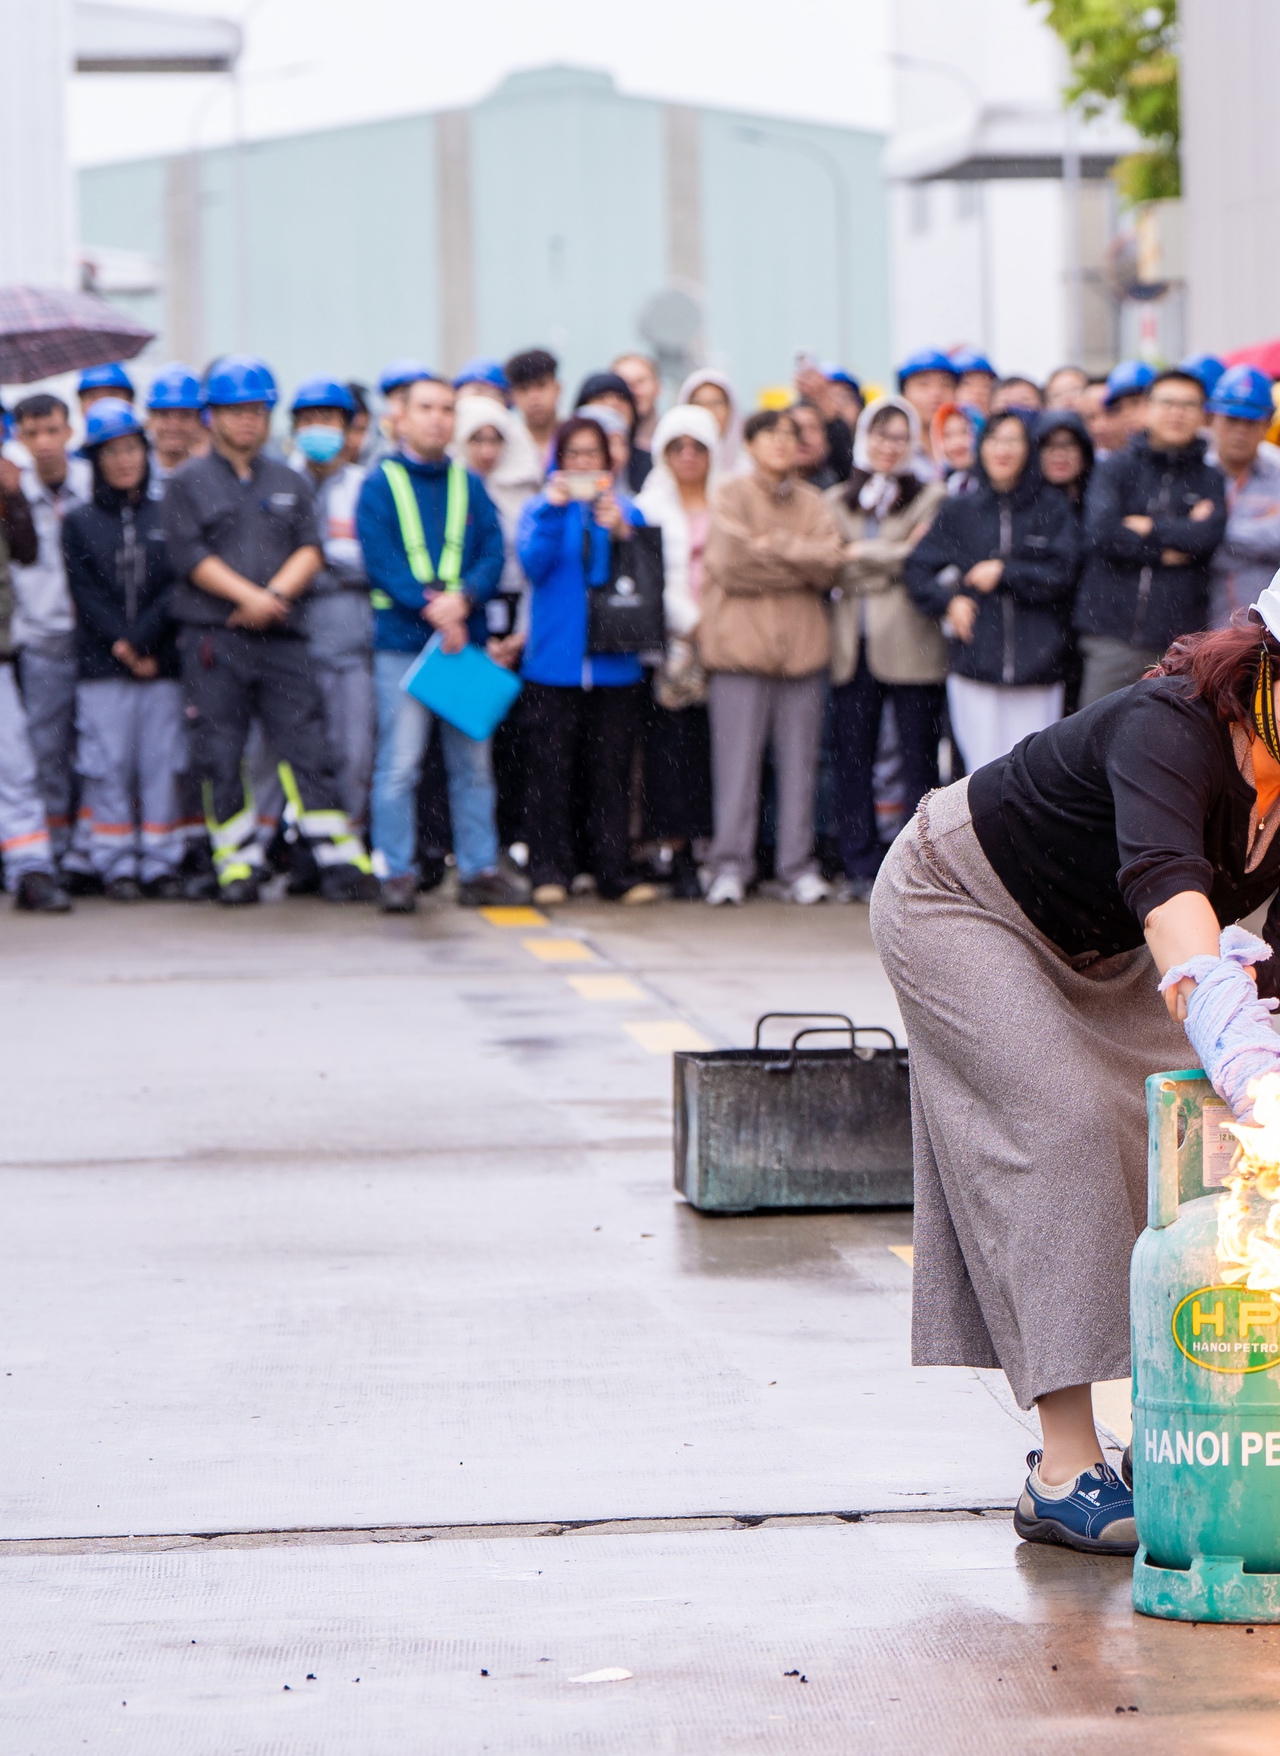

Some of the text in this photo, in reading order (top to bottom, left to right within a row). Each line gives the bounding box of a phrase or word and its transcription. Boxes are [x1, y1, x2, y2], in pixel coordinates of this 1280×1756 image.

[1219, 1133, 1227, 1141] 12
[1192, 1342, 1279, 1353] HANOI PETRO
[1145, 1428, 1229, 1466] HANOI
